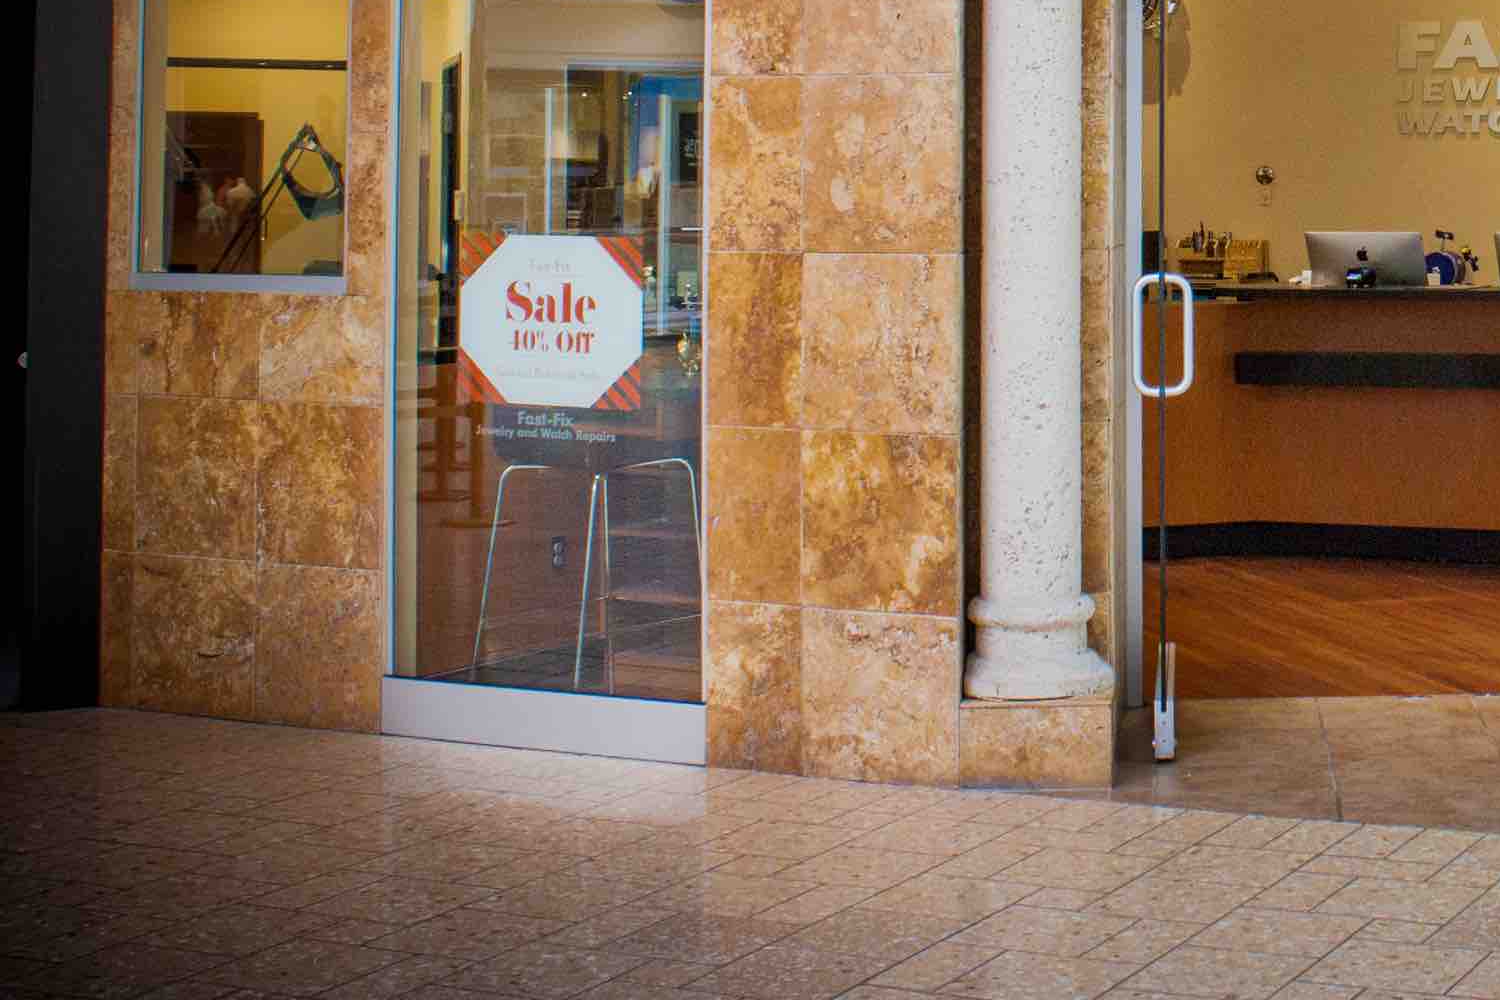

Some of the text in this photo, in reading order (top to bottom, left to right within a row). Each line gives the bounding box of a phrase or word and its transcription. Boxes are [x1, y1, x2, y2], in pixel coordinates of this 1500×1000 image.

[505, 280, 598, 326] Sale
[555, 328, 596, 354] Off
[516, 410, 574, 426] Fast-Fix
[516, 427, 538, 438] and
[540, 427, 572, 440] Watch
[576, 430, 617, 444] Repairs
